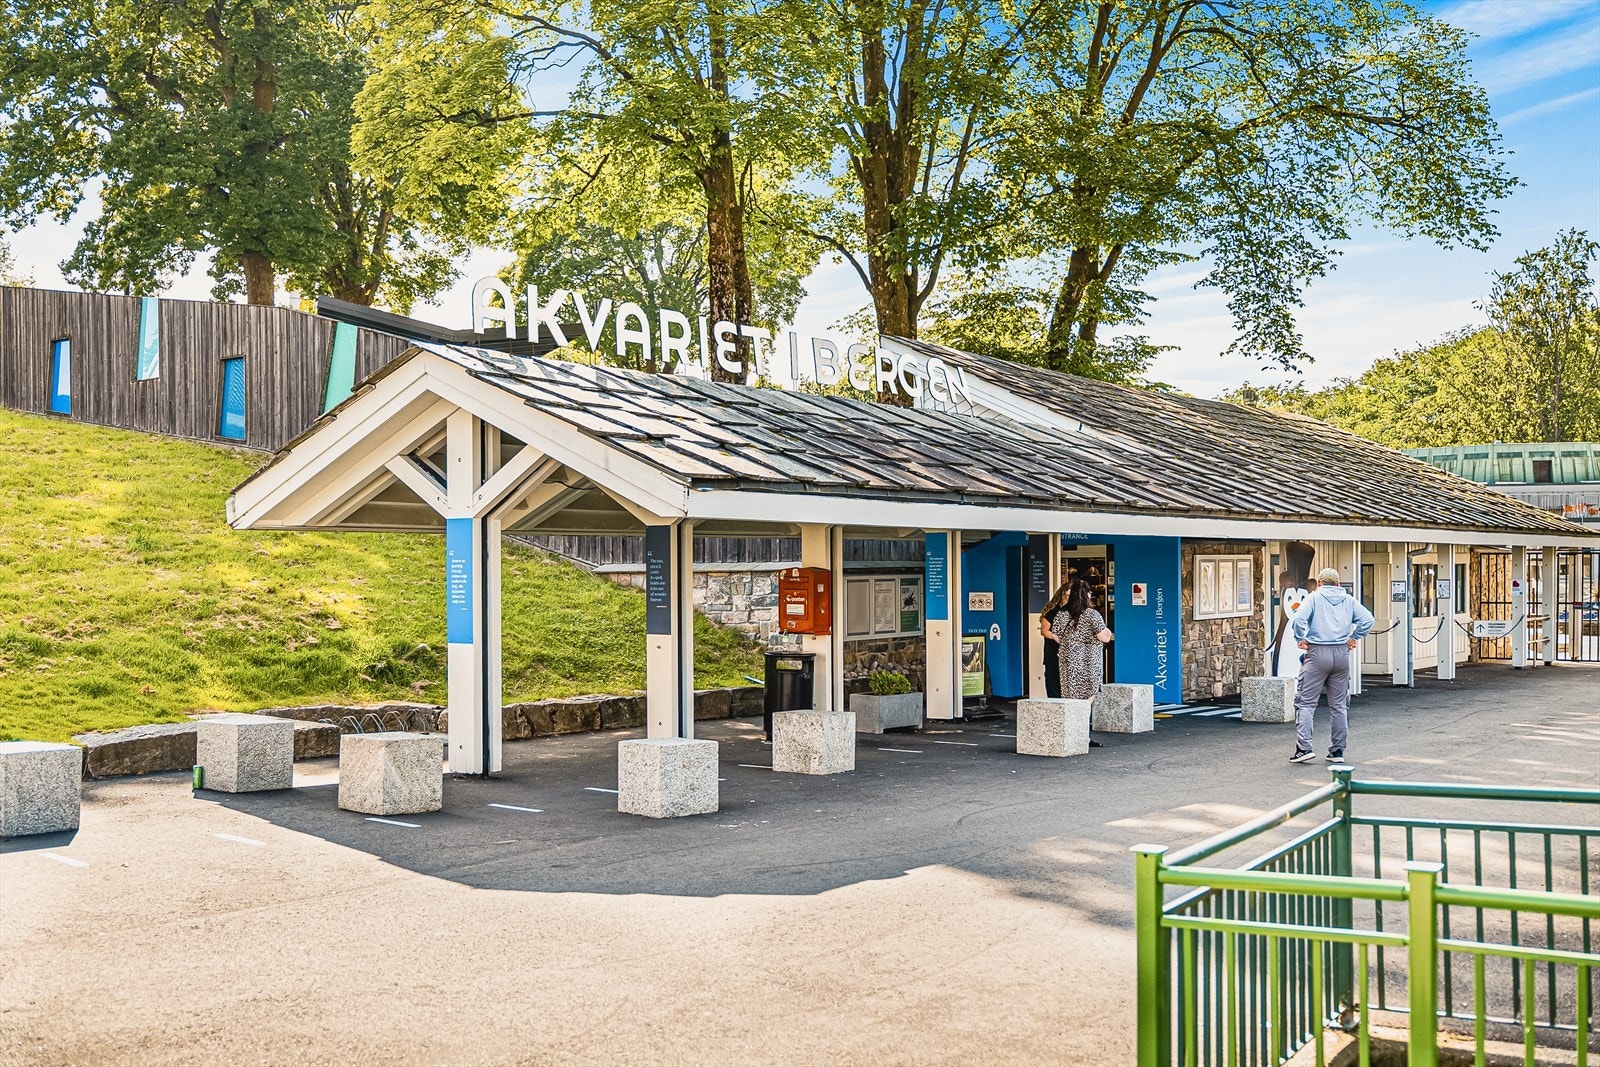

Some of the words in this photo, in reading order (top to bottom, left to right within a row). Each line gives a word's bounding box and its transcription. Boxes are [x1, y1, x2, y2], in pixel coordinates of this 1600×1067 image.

[472, 275, 771, 376] AKVARIET
[789, 331, 799, 380] I
[811, 336, 974, 408] BERGEN
[1155, 588, 1165, 616] Bergen
[1154, 628, 1168, 690] Akvariet
